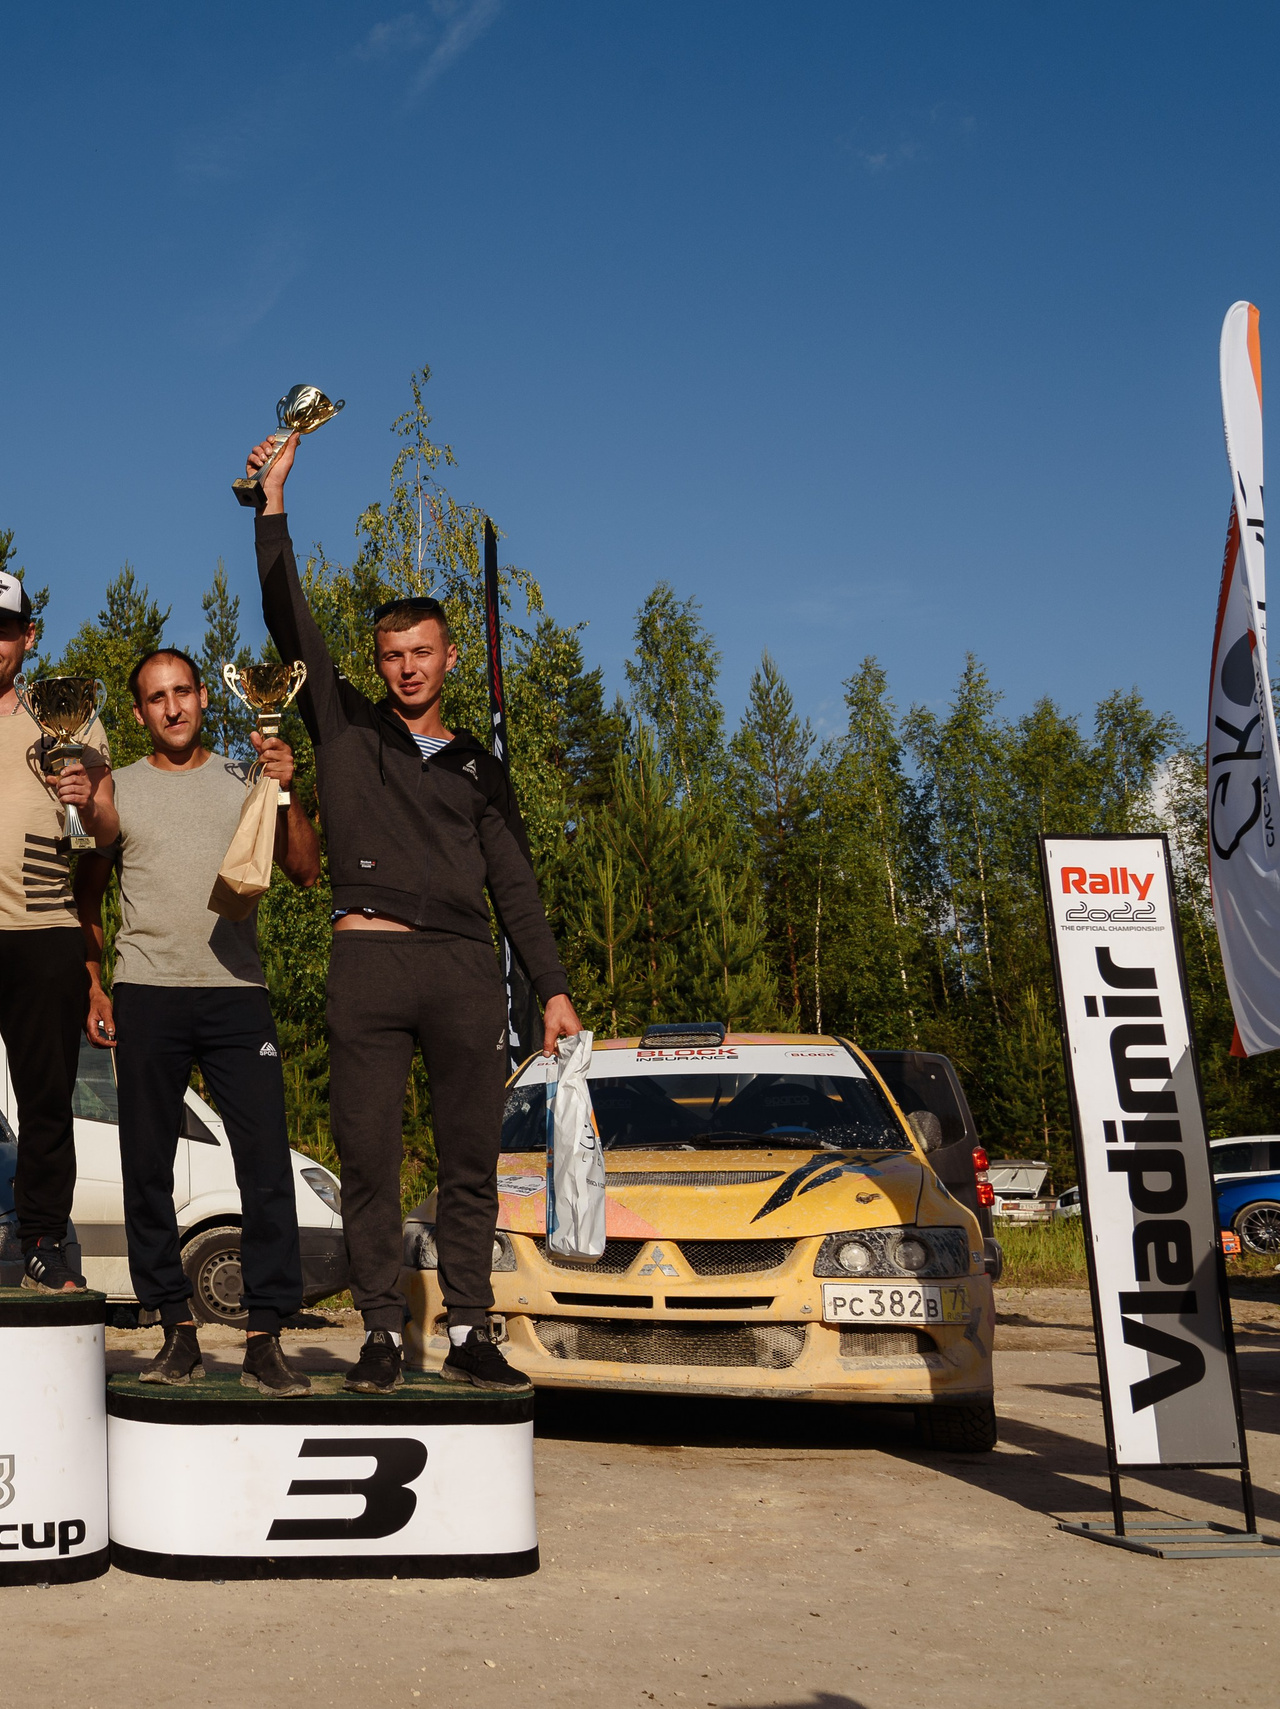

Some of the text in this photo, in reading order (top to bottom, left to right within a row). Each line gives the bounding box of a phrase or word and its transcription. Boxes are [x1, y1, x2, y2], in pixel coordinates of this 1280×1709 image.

[1060, 866, 1155, 900] Rally
[1065, 901, 1157, 922] 2022
[636, 1048, 738, 1057] BLOCK
[1084, 946, 1207, 1414] Vladimir
[266, 1437, 428, 1541] 3
